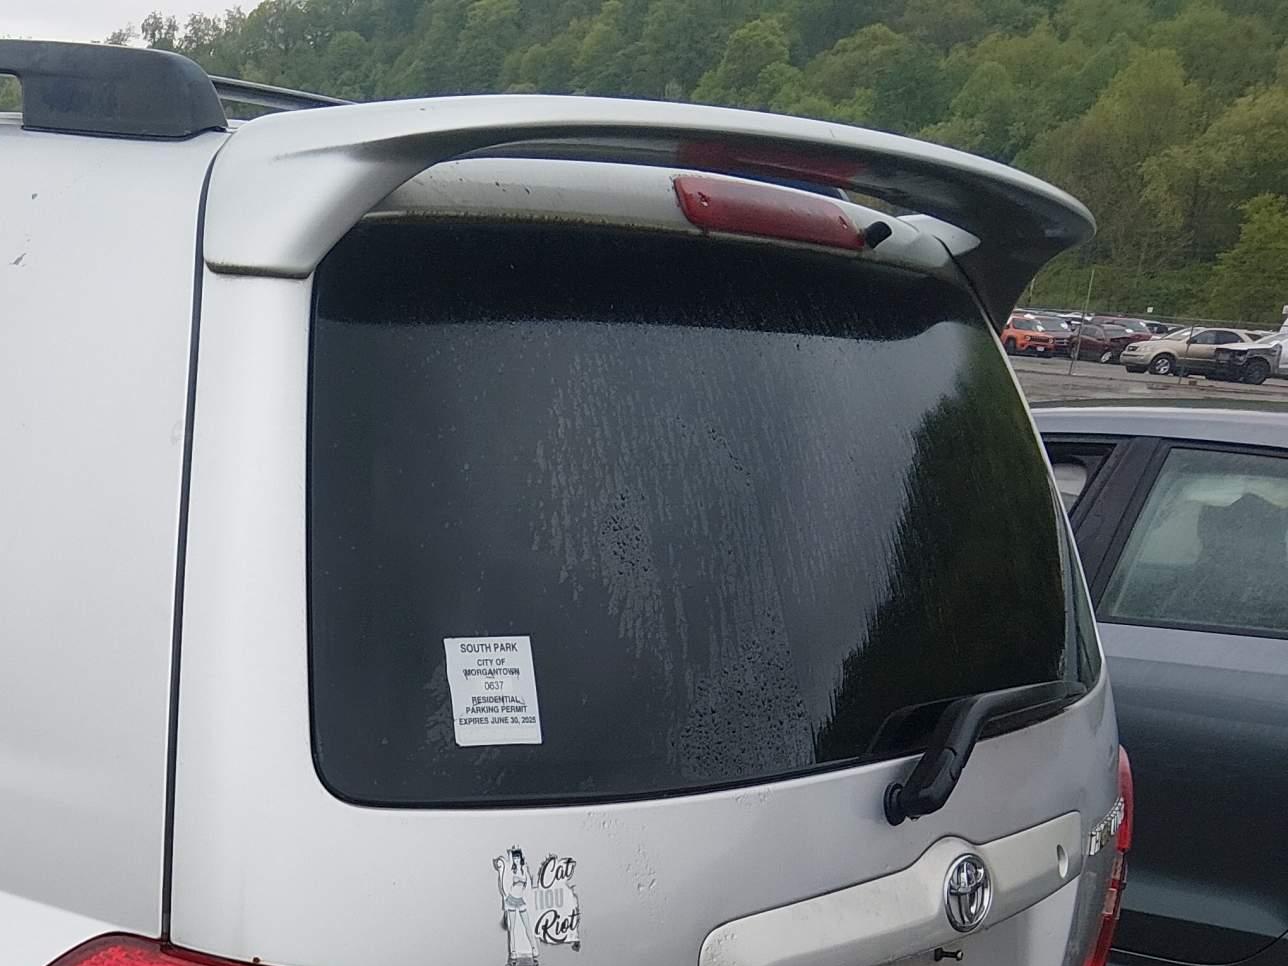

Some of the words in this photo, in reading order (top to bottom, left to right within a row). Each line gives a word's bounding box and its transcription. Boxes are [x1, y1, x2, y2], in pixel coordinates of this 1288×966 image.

[460, 643, 492, 653] SOUTH
[493, 643, 518, 652] PARK
[477, 658, 493, 666] CITY
[495, 658, 505, 666] OF
[464, 667, 520, 676] MORGANTOWN
[472, 696, 521, 704] RESIDENTIAL
[466, 706, 499, 714] PARKING
[501, 705, 527, 713] PERMIT
[459, 717, 489, 725] EXPIRES
[491, 716, 509, 724] JUNE
[540, 856, 576, 889] Cat
[535, 909, 581, 943] Riot
